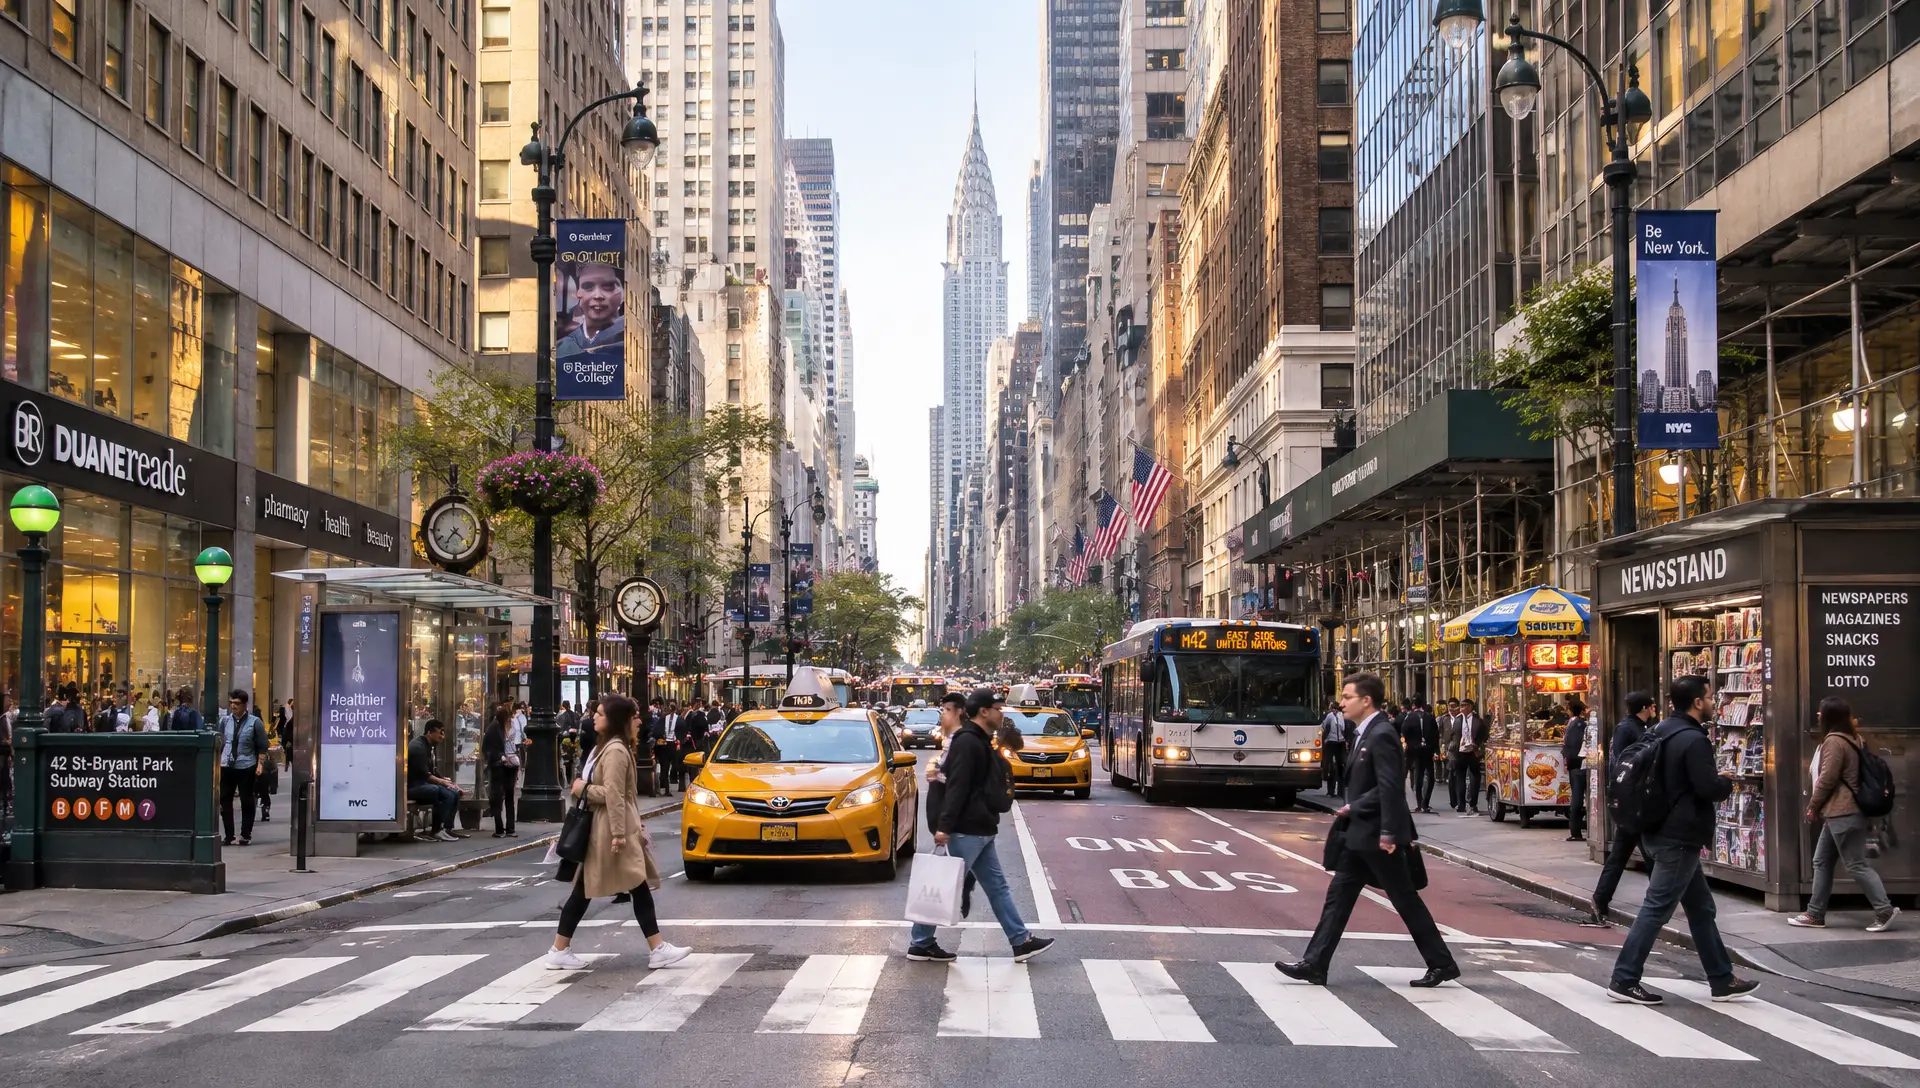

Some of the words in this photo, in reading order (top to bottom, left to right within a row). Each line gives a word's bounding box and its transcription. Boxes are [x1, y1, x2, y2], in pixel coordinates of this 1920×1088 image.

[1645, 224, 1662, 238] Be
[1645, 241, 1673, 254] New
[574, 361, 618, 374] Berkeley
[575, 372, 614, 385] College
[1665, 422, 1692, 433] NYC
[264, 494, 309, 529] pharmacy
[325, 510, 351, 538] health
[1621, 548, 1727, 595] NEWSSTAND
[1822, 592, 1908, 604] NEWSPAPERS
[1825, 613, 1900, 625] MAGAZINES
[1181, 630, 1207, 649] M42
[1226, 630, 1249, 640] EAST
[1254, 631, 1276, 640] SIDE
[1216, 640, 1248, 649] UNITED
[1251, 640, 1287, 650] NATIONS
[1826, 633, 1879, 645] SNACKS
[1827, 654, 1876, 666] DRINKS
[1827, 675, 1870, 687] LOTTO
[330, 693, 386, 706] Healthier
[330, 710, 382, 725] Brighter
[330, 726, 357, 738] New
[360, 726, 387, 738] York
[50, 756, 67, 770] 42
[72, 756, 138, 773] St-Bryant
[142, 757, 174, 771] Park
[50, 773, 104, 791] Subway
[108, 774, 157, 788] Station
[56, 801, 65, 815] B
[78, 801, 87, 815] D
[100, 801, 109, 815] F
[119, 802, 130, 815] M
[1065, 836, 1237, 856] ONLY
[1109, 868, 1299, 893] BUS
